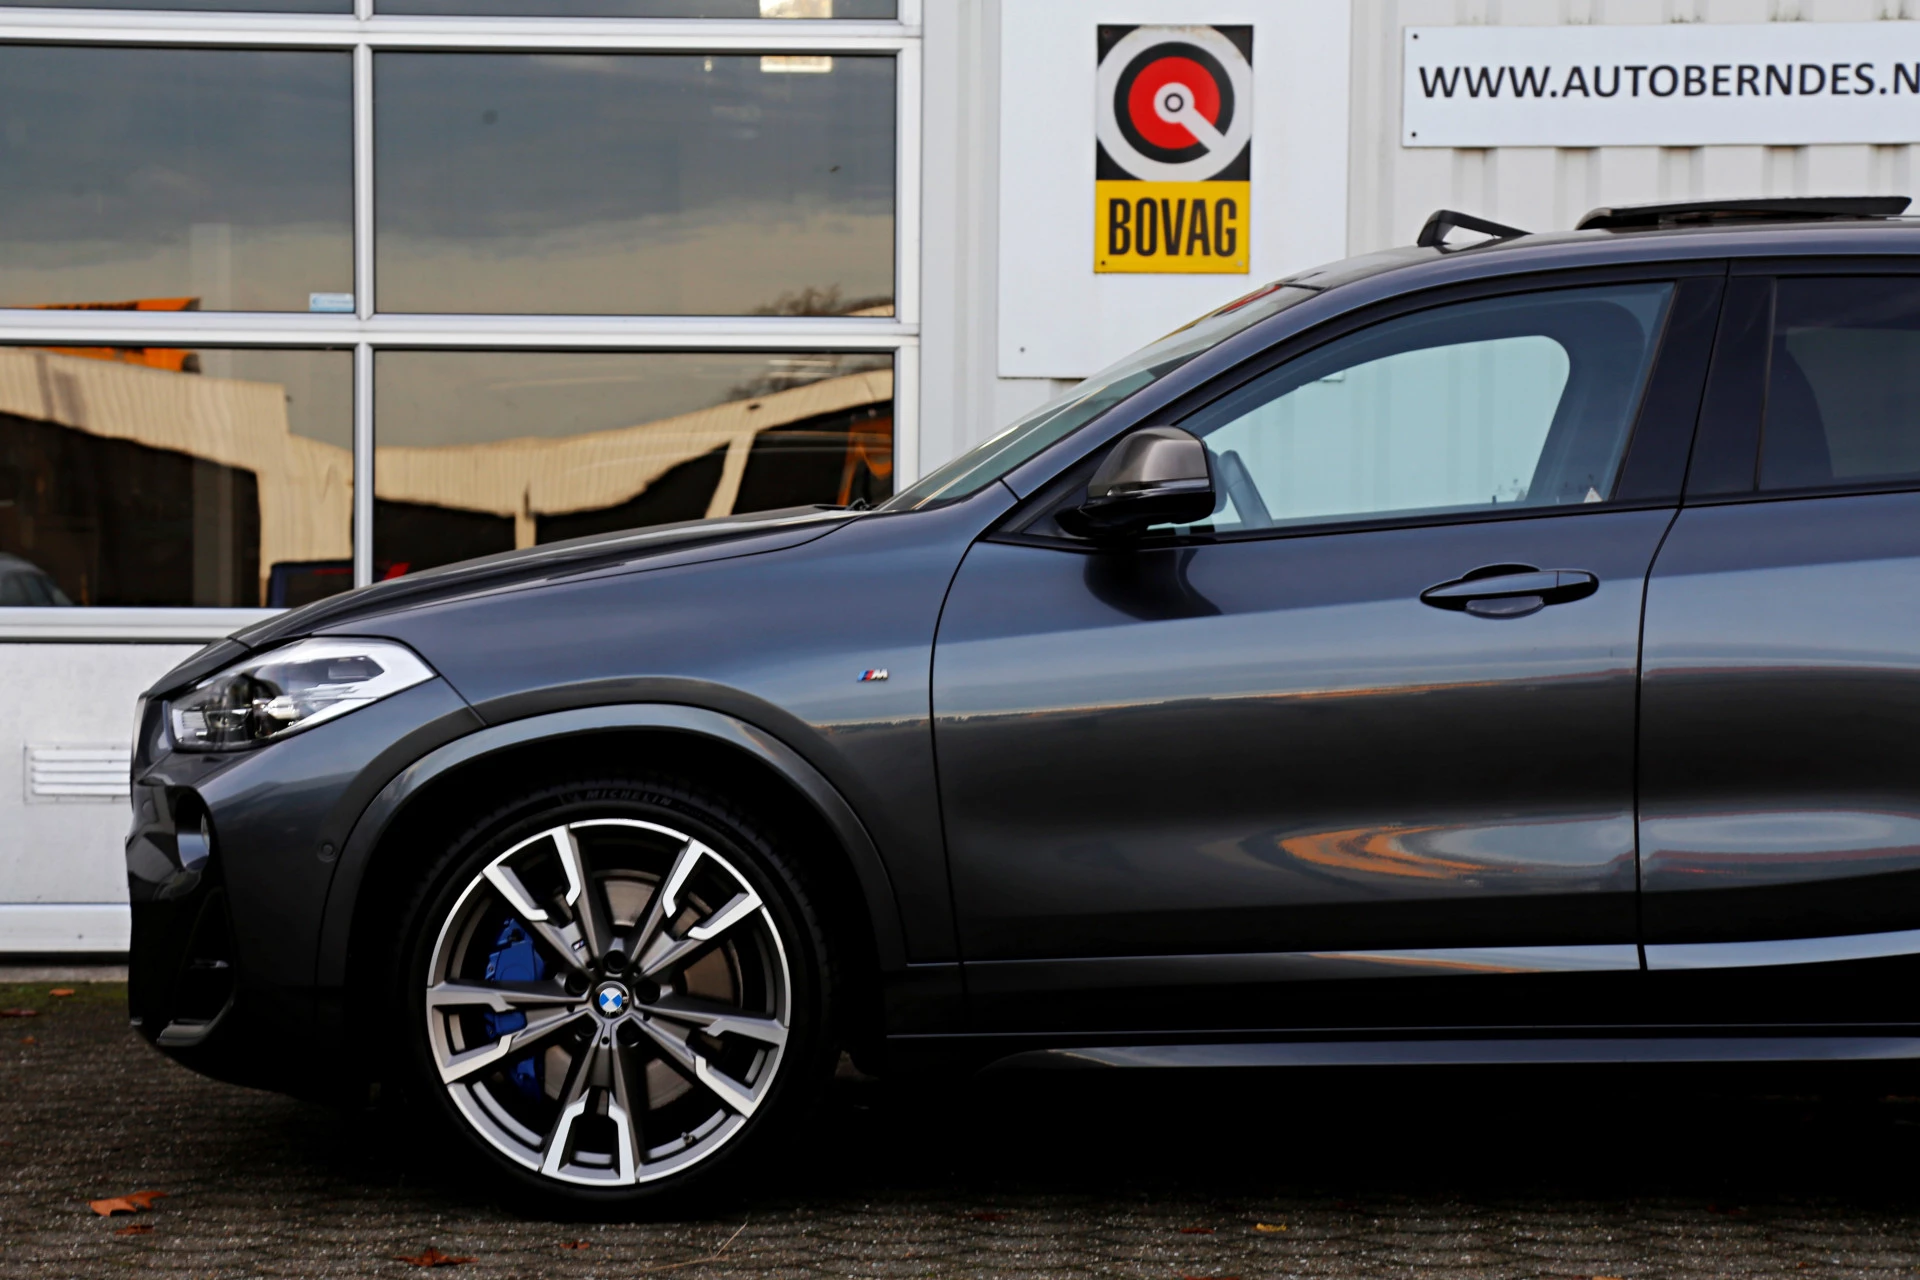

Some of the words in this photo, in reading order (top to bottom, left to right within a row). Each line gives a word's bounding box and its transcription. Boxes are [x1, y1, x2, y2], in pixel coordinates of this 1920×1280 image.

[1418, 62, 1920, 98] WWW.AUTOBERNDES.N
[1108, 196, 1238, 257] BOVAG
[585, 789, 673, 806] MICHELIN
